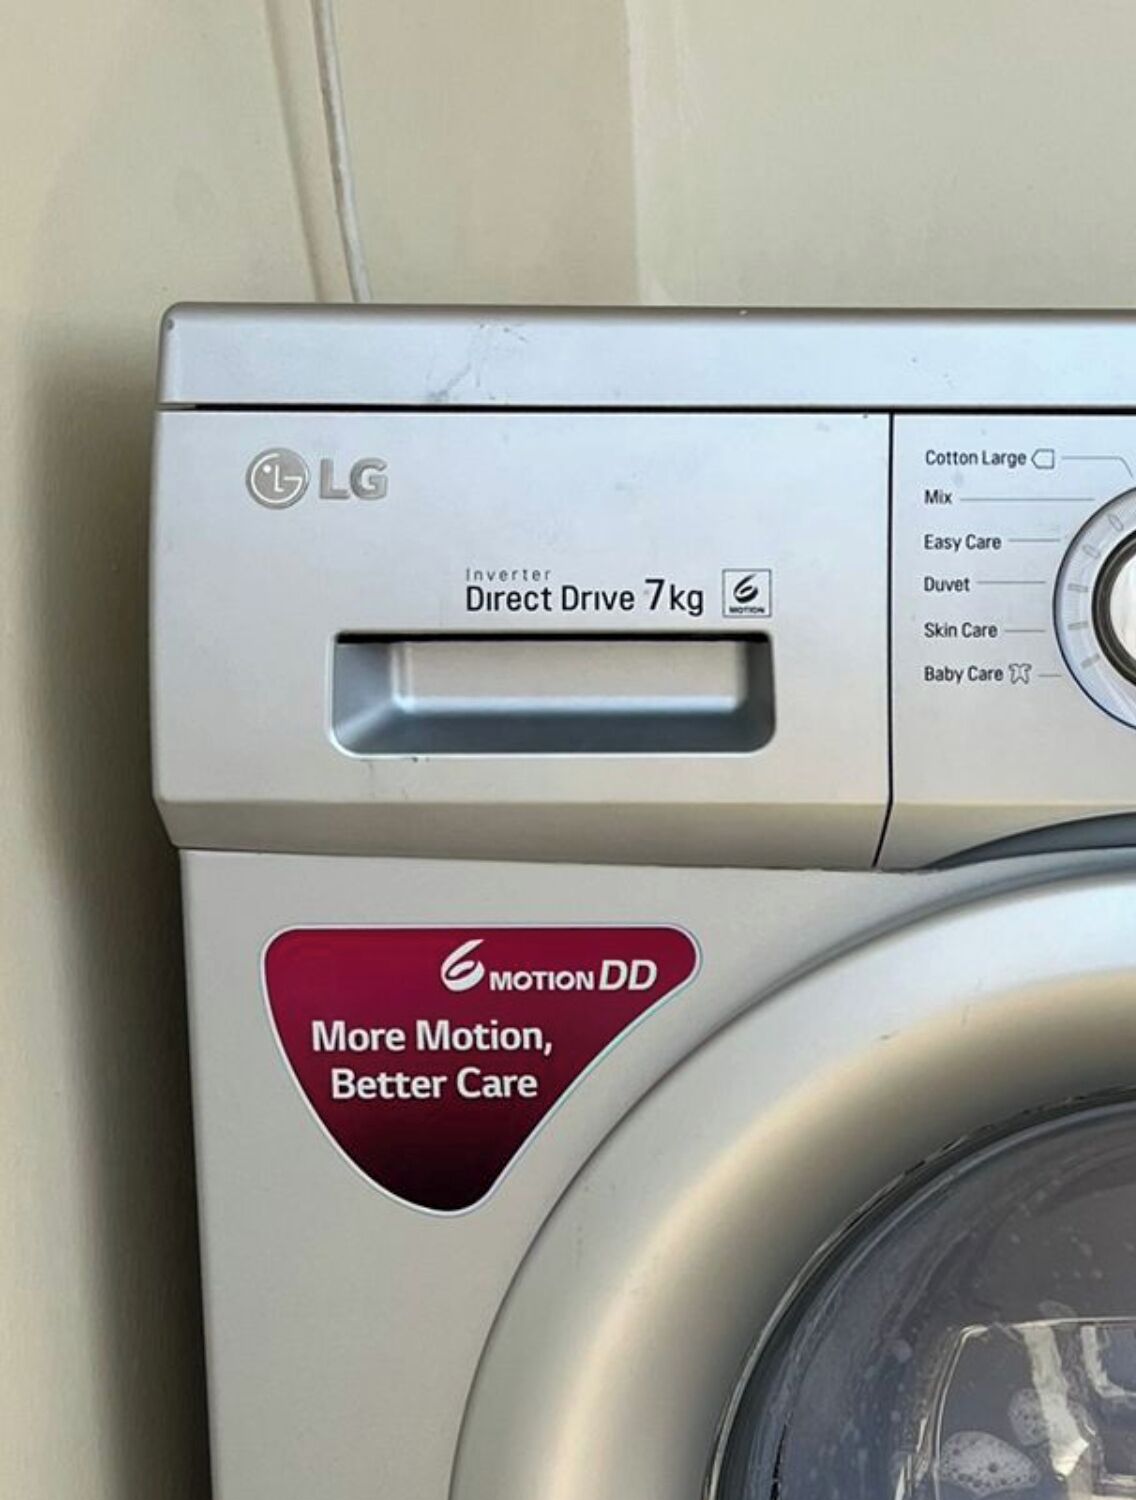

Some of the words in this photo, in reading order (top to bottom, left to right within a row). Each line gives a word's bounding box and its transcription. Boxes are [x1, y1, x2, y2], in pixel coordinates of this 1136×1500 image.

[926, 449, 979, 466] Cotton
[982, 449, 1027, 468] Large
[319, 458, 388, 500] LG
[924, 489, 953, 505] Mix
[924, 534, 962, 552] Easy
[965, 534, 1002, 550] Care
[466, 567, 552, 582] Inverter
[924, 576, 970, 592] Duvet
[466, 585, 553, 612] Direct
[561, 585, 636, 612] Drive
[924, 622, 958, 638] Skin
[961, 622, 998, 638] Care
[924, 666, 964, 685] Baby
[967, 666, 1004, 682] Care
[489, 970, 594, 991] MOTION
[599, 959, 658, 991] DD
[311, 1019, 406, 1053] More
[415, 1019, 553, 1056] Motion,
[330, 1067, 447, 1100] Better
[456, 1066, 539, 1098] Care
